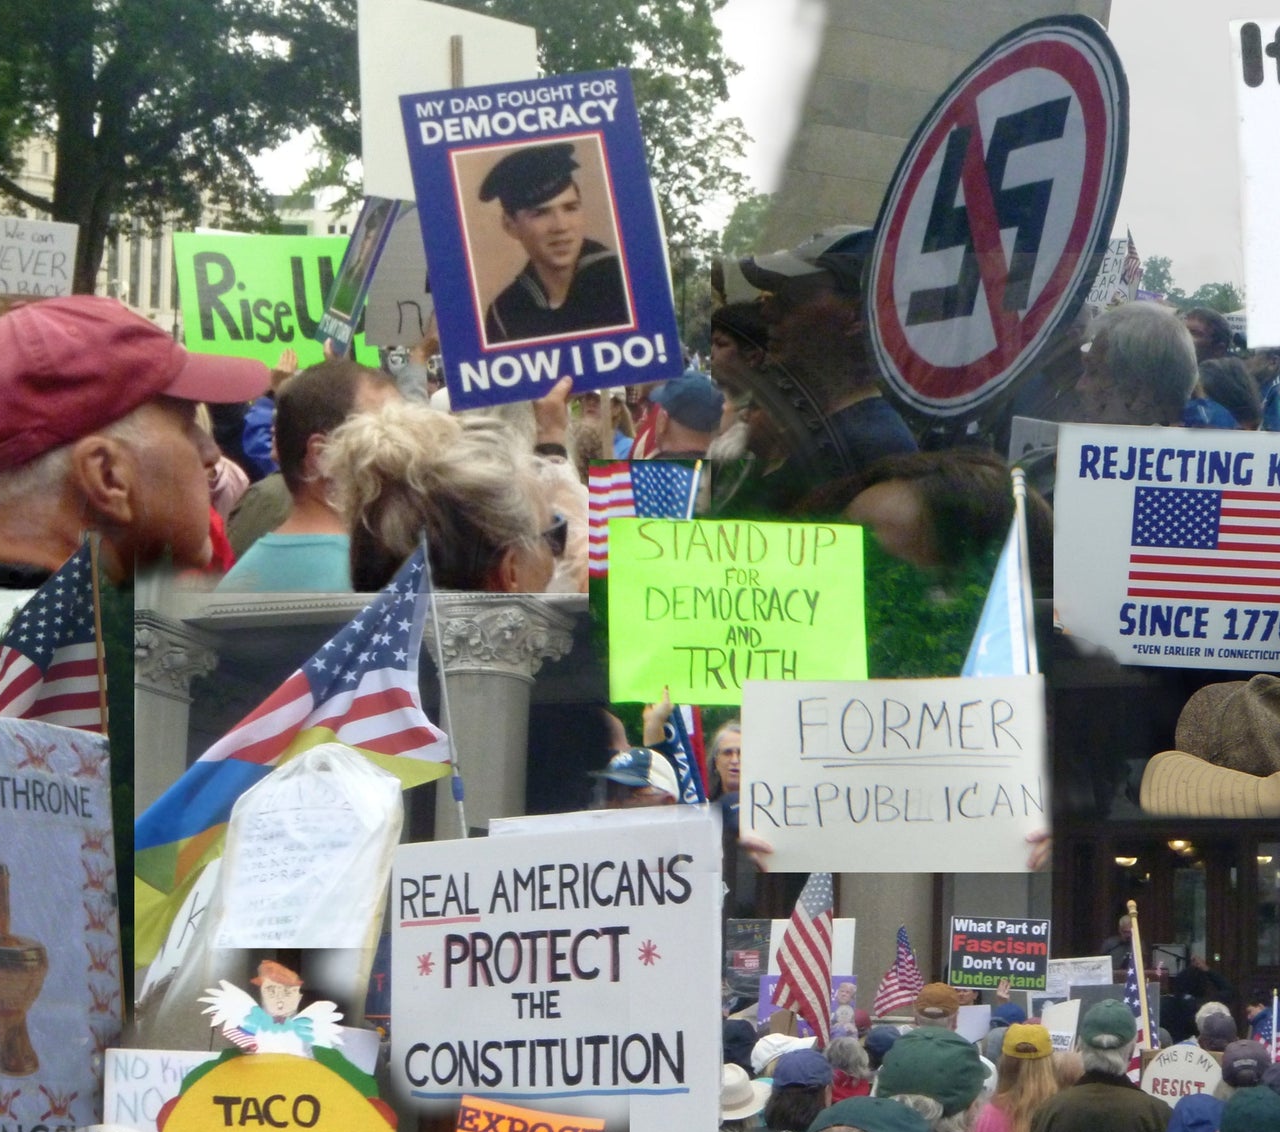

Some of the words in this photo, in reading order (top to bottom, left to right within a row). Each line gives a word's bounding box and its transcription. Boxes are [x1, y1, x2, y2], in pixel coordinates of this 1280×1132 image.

[415, 99, 445, 118] MY
[450, 94, 492, 115] DAD
[497, 84, 573, 108] FOUGHT
[579, 80, 617, 97] FOR
[419, 98, 619, 145] DEMOCRACY
[459, 349, 560, 393] NOW
[572, 346, 585, 375] I
[593, 334, 668, 373] DO!
[1079, 444, 1254, 487] REJECTING
[1119, 603, 1210, 639] SINCE
[1164, 645, 1200, 658] EARLIER
[1204, 648, 1215, 658] IN
[1218, 648, 1280, 662] CONNECTICUT
[400, 872, 479, 920] REAL
[488, 854, 694, 914] AMERICANS
[953, 934, 1047, 955] Fascism
[954, 918, 992, 933] What
[996, 920, 1027, 935] Part
[1032, 922, 1048, 935] of
[443, 926, 630, 988] PROTECT
[962, 955, 1003, 970] Don't
[1006, 957, 1036, 972] You
[951, 970, 1045, 988] Understand
[512, 990, 561, 1019] THE
[405, 1031, 685, 1087] CONSTITUTION
[213, 1094, 321, 1129] TACO
